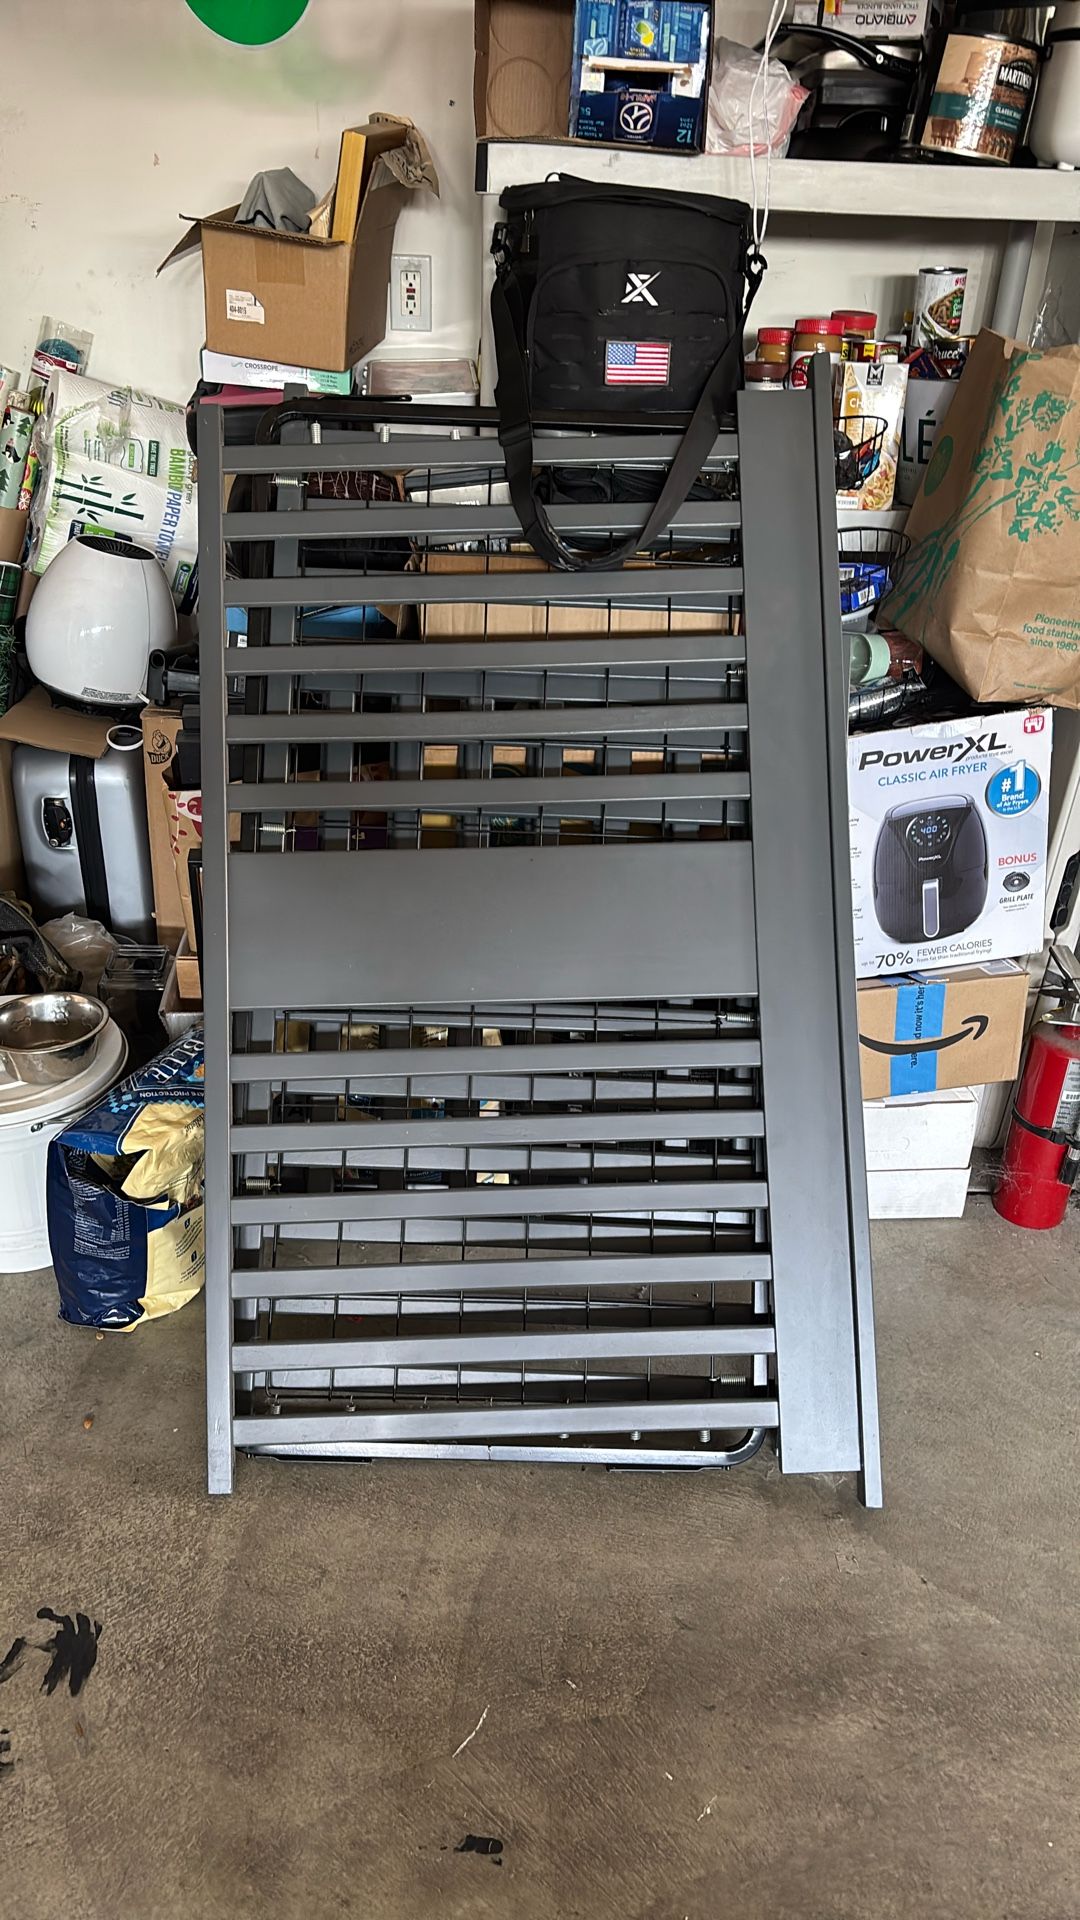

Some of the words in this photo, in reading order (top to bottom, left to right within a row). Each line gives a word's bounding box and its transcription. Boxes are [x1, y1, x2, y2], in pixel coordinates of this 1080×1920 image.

[884, 2, 901, 10] HAND
[855, 14, 917, 26] AMBIANO
[676, 129, 692, 143] 12
[244, 362, 279, 372] CROSSROPE
[163, 491, 182, 527] PAPER
[155, 529, 176, 568] TOWEL
[1023, 623, 1045, 635] food
[1030, 636, 1054, 648] since
[1056, 641, 1079, 652] 1980.
[151, 753, 169, 763] DUCK
[858, 732, 1008, 771] PowerXL
[878, 771, 926, 787] CLASSIC
[929, 768, 949, 778] AIR
[951, 762, 988, 776] FRYER
[1001, 759, 1026, 793] #1
[1002, 791, 1025, 802] Brand
[920, 825, 938, 834] 400
[998, 852, 1037, 866] BONUS
[999, 895, 1016, 904] GRILL
[1016, 893, 1034, 902] PLATE
[875, 950, 914, 969] 70%
[917, 945, 948, 958] FEWER
[949, 938, 993, 952] CALORIES
[915, 1000, 924, 1014] it's
[144, 1039, 204, 1084] BLUE
[910, 1051, 918, 1069] ere.
